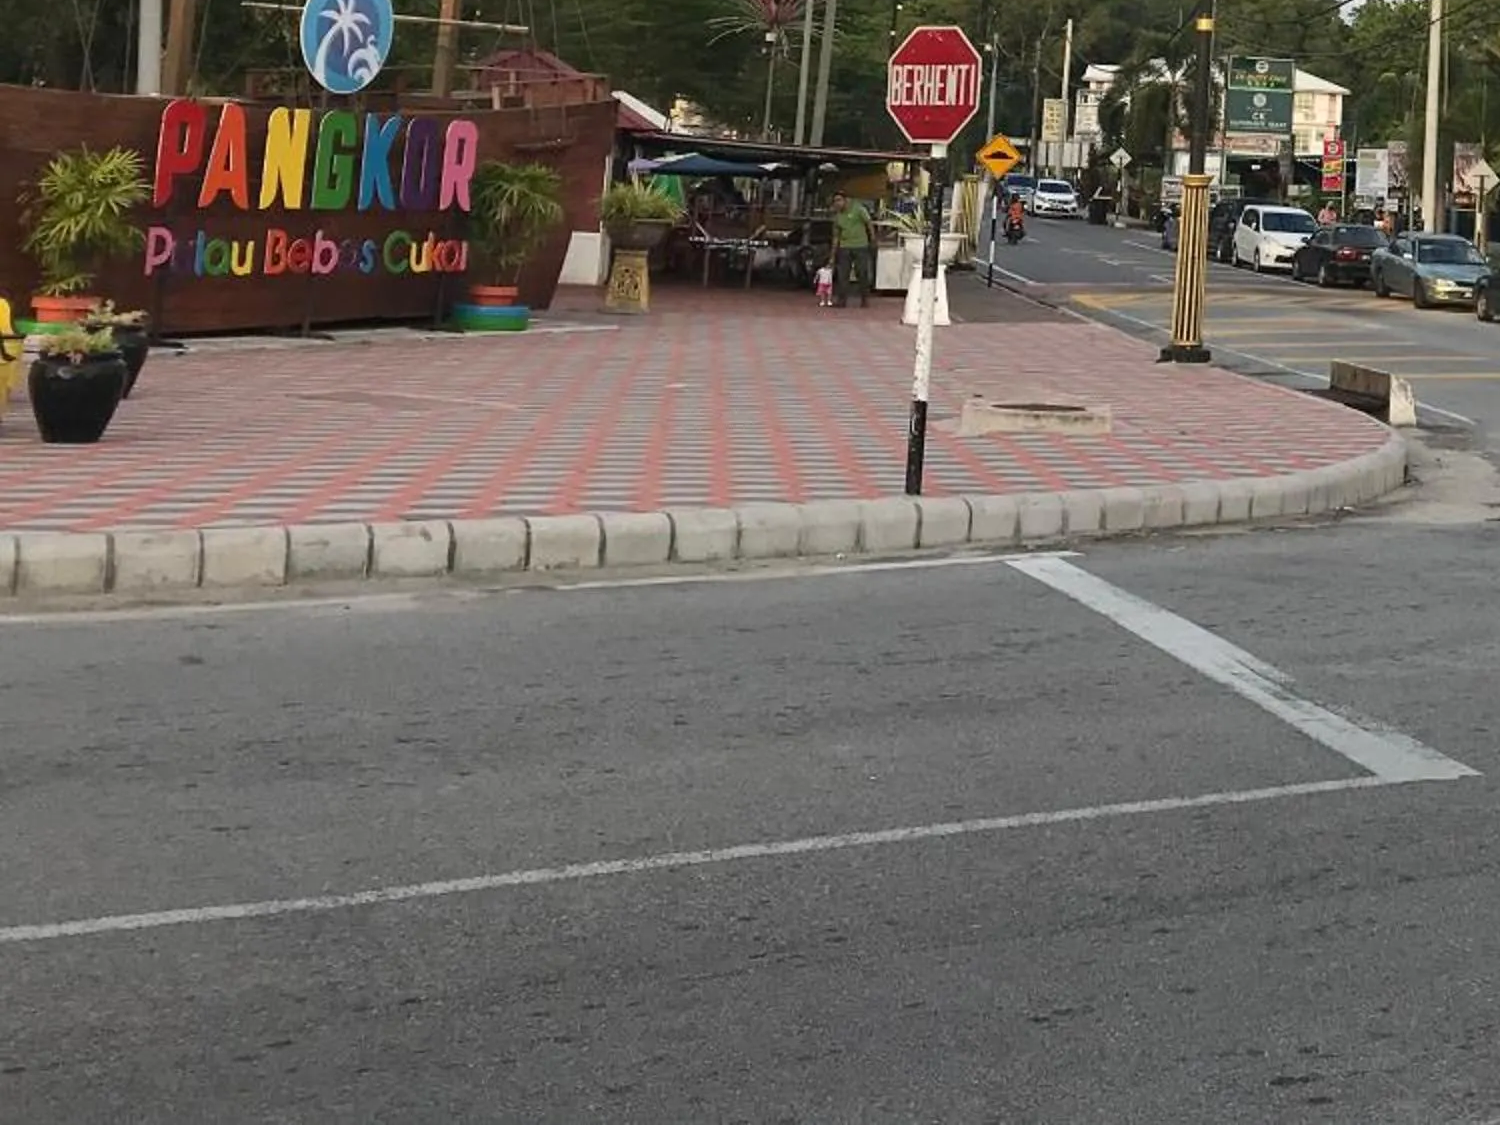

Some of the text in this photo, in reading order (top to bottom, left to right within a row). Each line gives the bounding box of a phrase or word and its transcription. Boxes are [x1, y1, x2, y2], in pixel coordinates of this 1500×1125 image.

[891, 64, 977, 107] BERHENTI
[152, 99, 480, 213] PANGKOR
[144, 226, 255, 277] Plau
